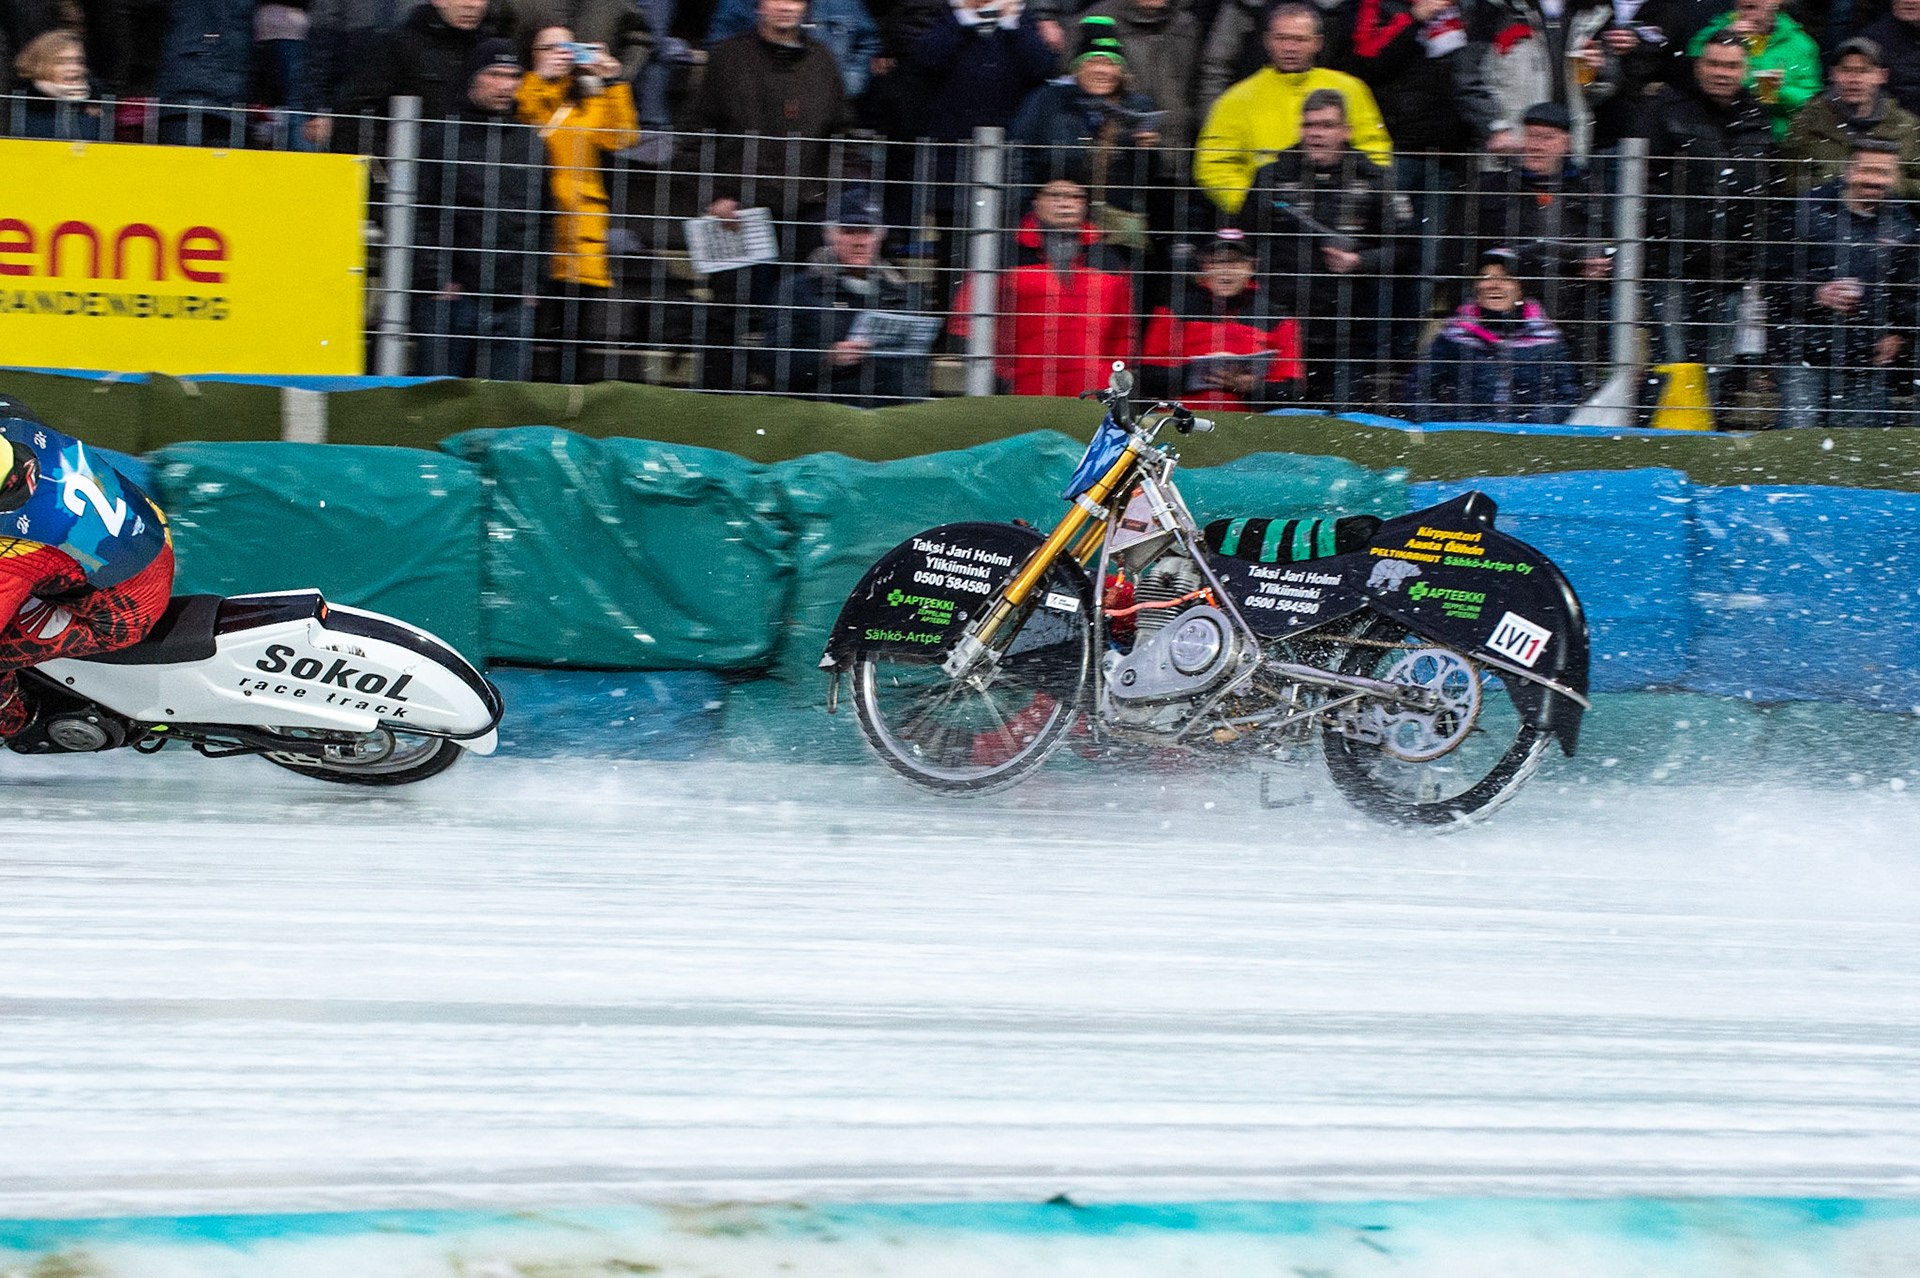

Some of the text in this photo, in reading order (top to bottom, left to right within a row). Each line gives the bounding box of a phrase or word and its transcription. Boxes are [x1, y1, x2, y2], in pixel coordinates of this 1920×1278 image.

[63, 474, 127, 538] 2
[912, 538, 1013, 567] Taksi Jari Holmi
[1404, 538, 1443, 551] Aasta
[925, 557, 991, 579] Ylikiiminki
[1248, 565, 1342, 586] Taksi Jari Holmi
[1515, 562, 1534, 575] Oy
[914, 571, 991, 595] 0500 584580
[1259, 582, 1322, 599] Ylikiiminki
[1244, 595, 1320, 615] 0500 584580
[1427, 587, 1486, 603] APTEEKKI
[864, 629, 942, 645] Sähkö-Artpe
[1495, 623, 1541, 661] LVI1
[238, 677, 409, 718] race track
